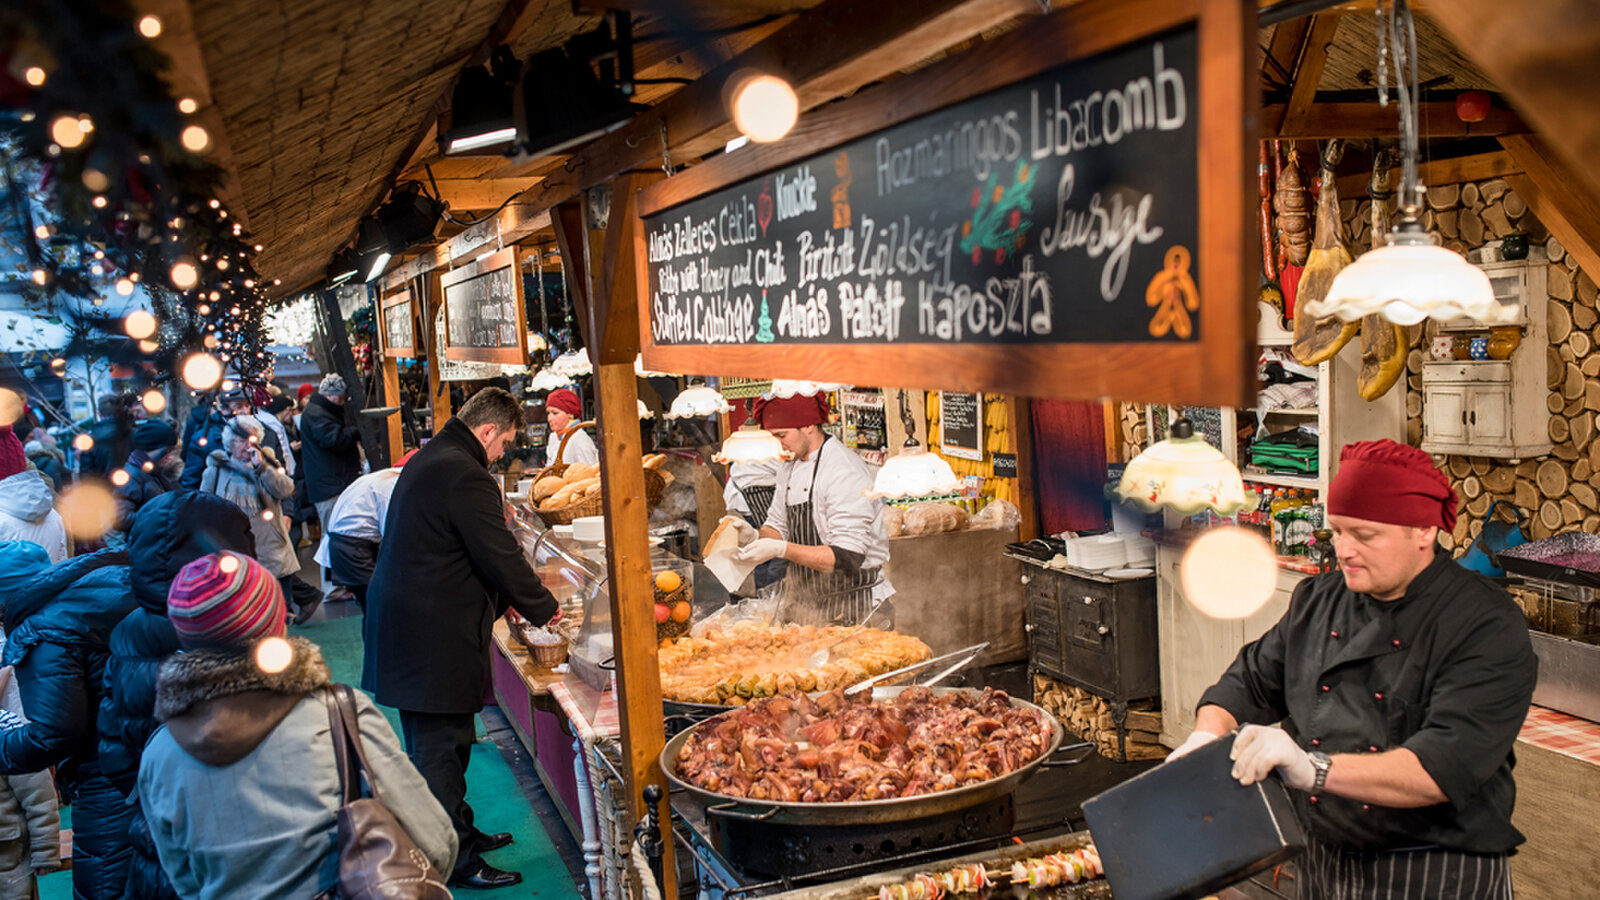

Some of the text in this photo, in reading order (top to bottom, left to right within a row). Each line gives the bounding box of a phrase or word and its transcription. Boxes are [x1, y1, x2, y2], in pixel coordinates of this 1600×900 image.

[1031, 42, 1187, 161] Libacomb
[719, 195, 757, 246] Cékla
[732, 249, 752, 288] and
[652, 291, 691, 343] Stuffed
